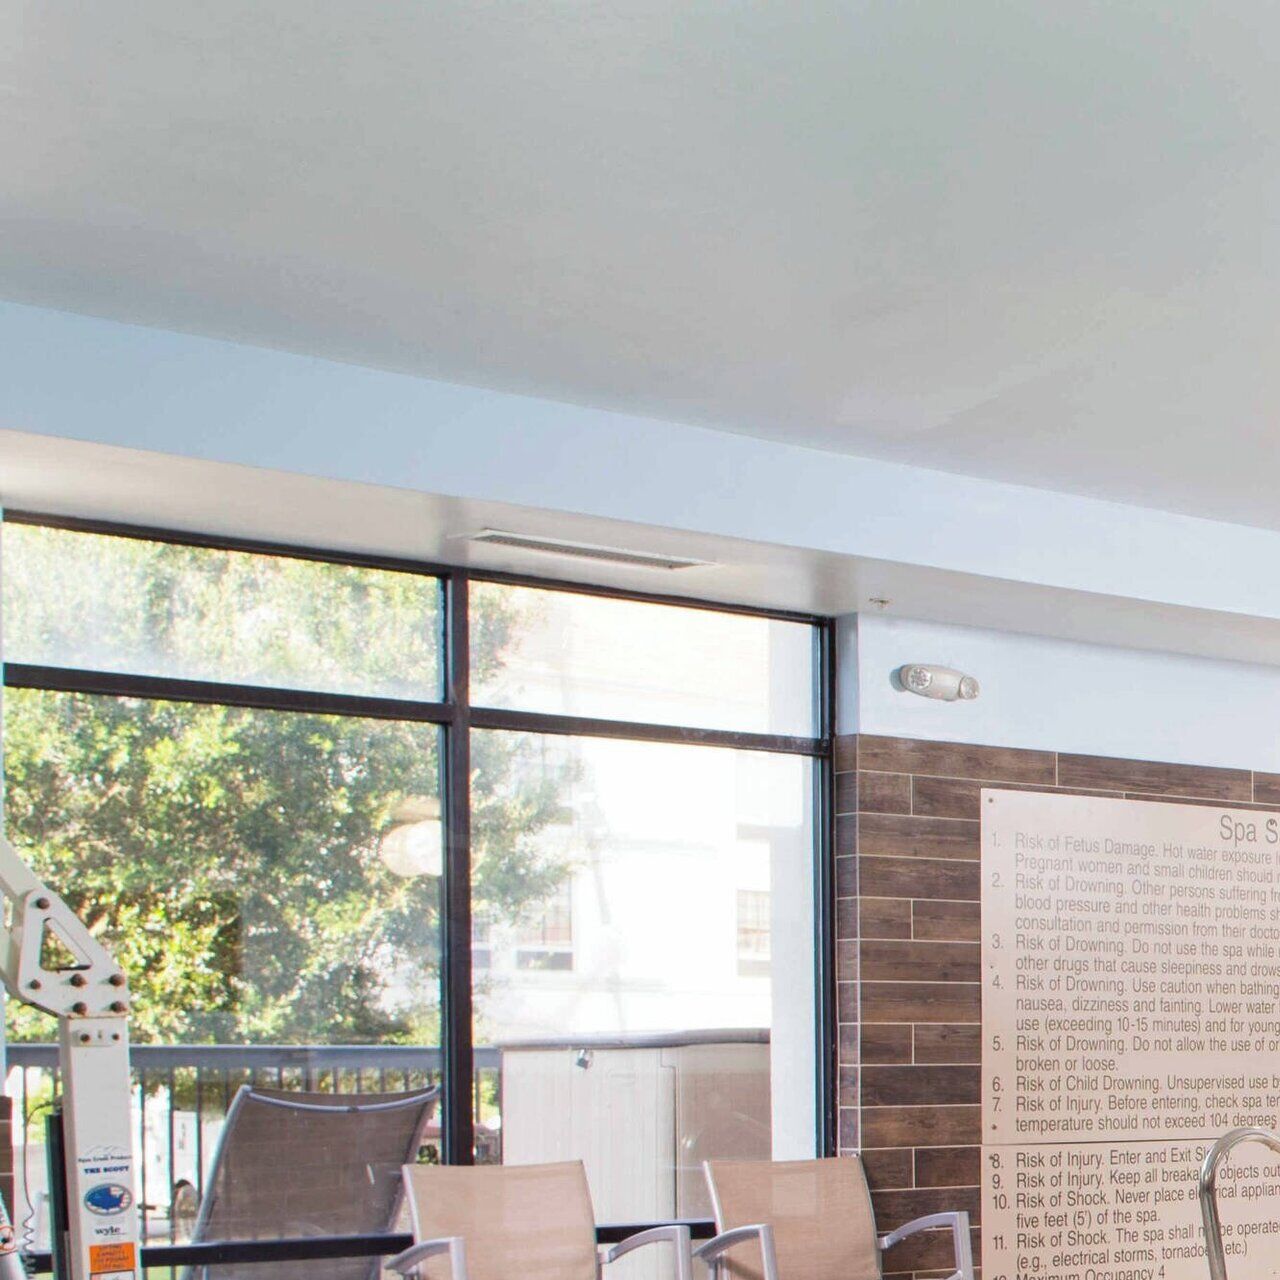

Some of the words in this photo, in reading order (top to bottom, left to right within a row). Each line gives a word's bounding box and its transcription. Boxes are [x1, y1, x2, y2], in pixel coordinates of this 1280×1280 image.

[1220, 814, 1257, 847] Spa
[1016, 1056, 1060, 1071] broken
[1065, 1059, 1078, 1071] or
[1082, 1056, 1119, 1071] loose.
[992, 1077, 1004, 1091] 6.
[1016, 1076, 1045, 1091] Risk
[1049, 1076, 1062, 1091] of
[1066, 1076, 1099, 1091] Child
[1103, 1076, 1163, 1093] Drowning.
[1167, 1075, 1245, 1092] Unsupervised
[1249, 1078, 1269, 1089] use
[992, 1097, 1002, 1111] 7.
[1016, 1096, 1045, 1111] Risk
[1049, 1096, 1062, 1111] of
[1067, 1096, 1103, 1114] Injury.
[1108, 1095, 1148, 1110] Before
[1151, 1095, 1201, 1112] entering,
[1205, 1094, 1239, 1108] check
[1242, 1096, 1263, 1110] spa
[1016, 1117, 1094, 1134] temperature
[1098, 1114, 1138, 1130] should
[1143, 1115, 1161, 1128] not
[1164, 1113, 1206, 1128] exceed
[1210, 1112, 1229, 1127] 104
[1232, 1112, 1278, 1129] degrees
[992, 1153, 1004, 1168] 8.
[1016, 1152, 1045, 1167] Risk
[1050, 1151, 1062, 1166] of
[1068, 1151, 1104, 1169] Injury.
[1110, 1150, 1142, 1164] Enter
[1145, 1148, 1167, 1163] and
[1171, 1148, 1192, 1162] Exit
[1195, 1146, 1232, 1164] Sly.
[992, 1174, 1004, 1189] 9.
[1016, 1172, 1045, 1188] Risk
[1050, 1171, 1062, 1186] of
[1067, 1171, 1104, 1188] Injury.
[1110, 1169, 1141, 1186] Keep
[1145, 1168, 1158, 1182] all
[1162, 1166, 1202, 1182] breaka
[1219, 1165, 1260, 1182] objects
[1263, 1164, 1280, 1177] out
[993, 1194, 1010, 1209] 10.
[1016, 1192, 1046, 1208] Risk
[1049, 1191, 1062, 1207] of
[1067, 1190, 1110, 1206] Shock.
[1115, 1189, 1150, 1203] Never
[1154, 1187, 1185, 1205] place
[1016, 1213, 1039, 1228] five
[1044, 1212, 1068, 1227] feet
[1097, 1209, 1109, 1224] of
[1113, 1208, 1132, 1223] the
[1136, 1210, 1161, 1225] spa.
[993, 1235, 1008, 1250] 11.
[1017, 1233, 1046, 1249] Risk
[1050, 1232, 1063, 1247] of
[1067, 1229, 1111, 1246] Shock.
[1115, 1228, 1139, 1243] The
[1143, 1229, 1164, 1244] spa
[1168, 1224, 1194, 1239] shall
[1052, 1249, 1110, 1267] electrical
[1114, 1249, 1157, 1263] storms,
[1162, 1243, 1208, 1259] tornado
[1225, 1240, 1247, 1257] etc.)
[1158, 1265, 1165, 1278] 4
